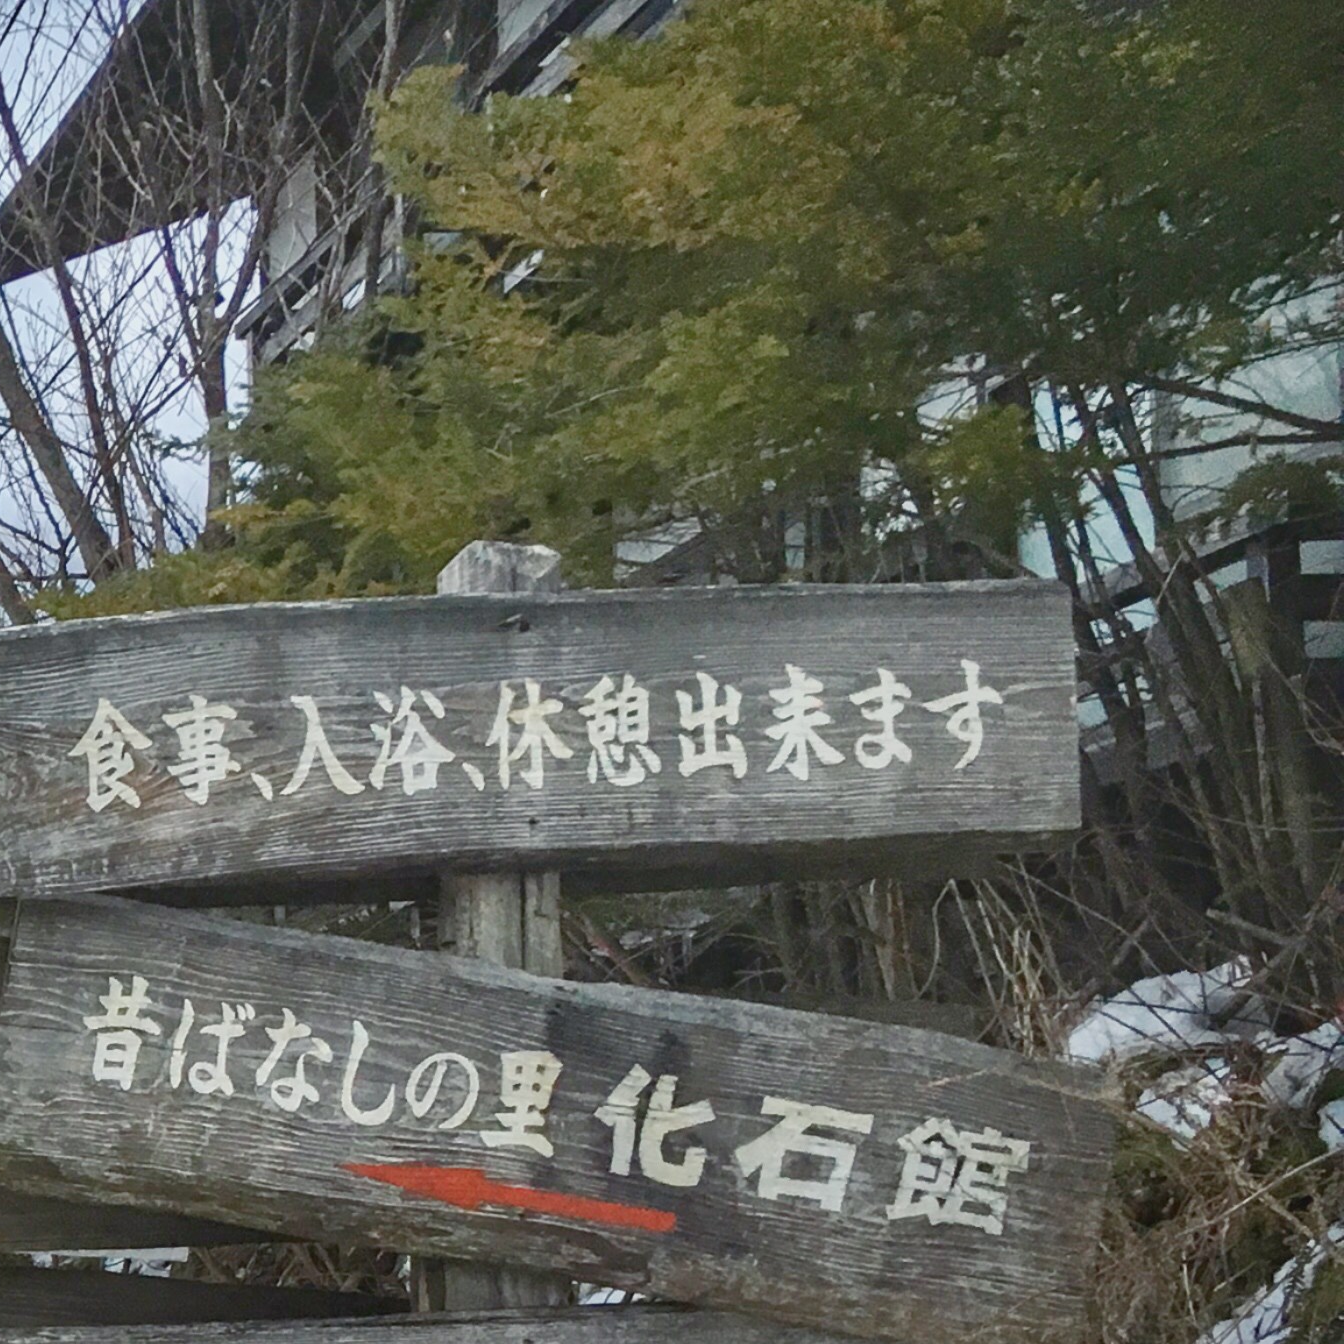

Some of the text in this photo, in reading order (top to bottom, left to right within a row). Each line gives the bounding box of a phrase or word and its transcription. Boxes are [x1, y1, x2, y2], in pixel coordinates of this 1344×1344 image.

[67, 659, 1004, 812] 食事、入浴、休憩出来ます
[83, 976, 1030, 1234] 昔ばなしの里 化石館
